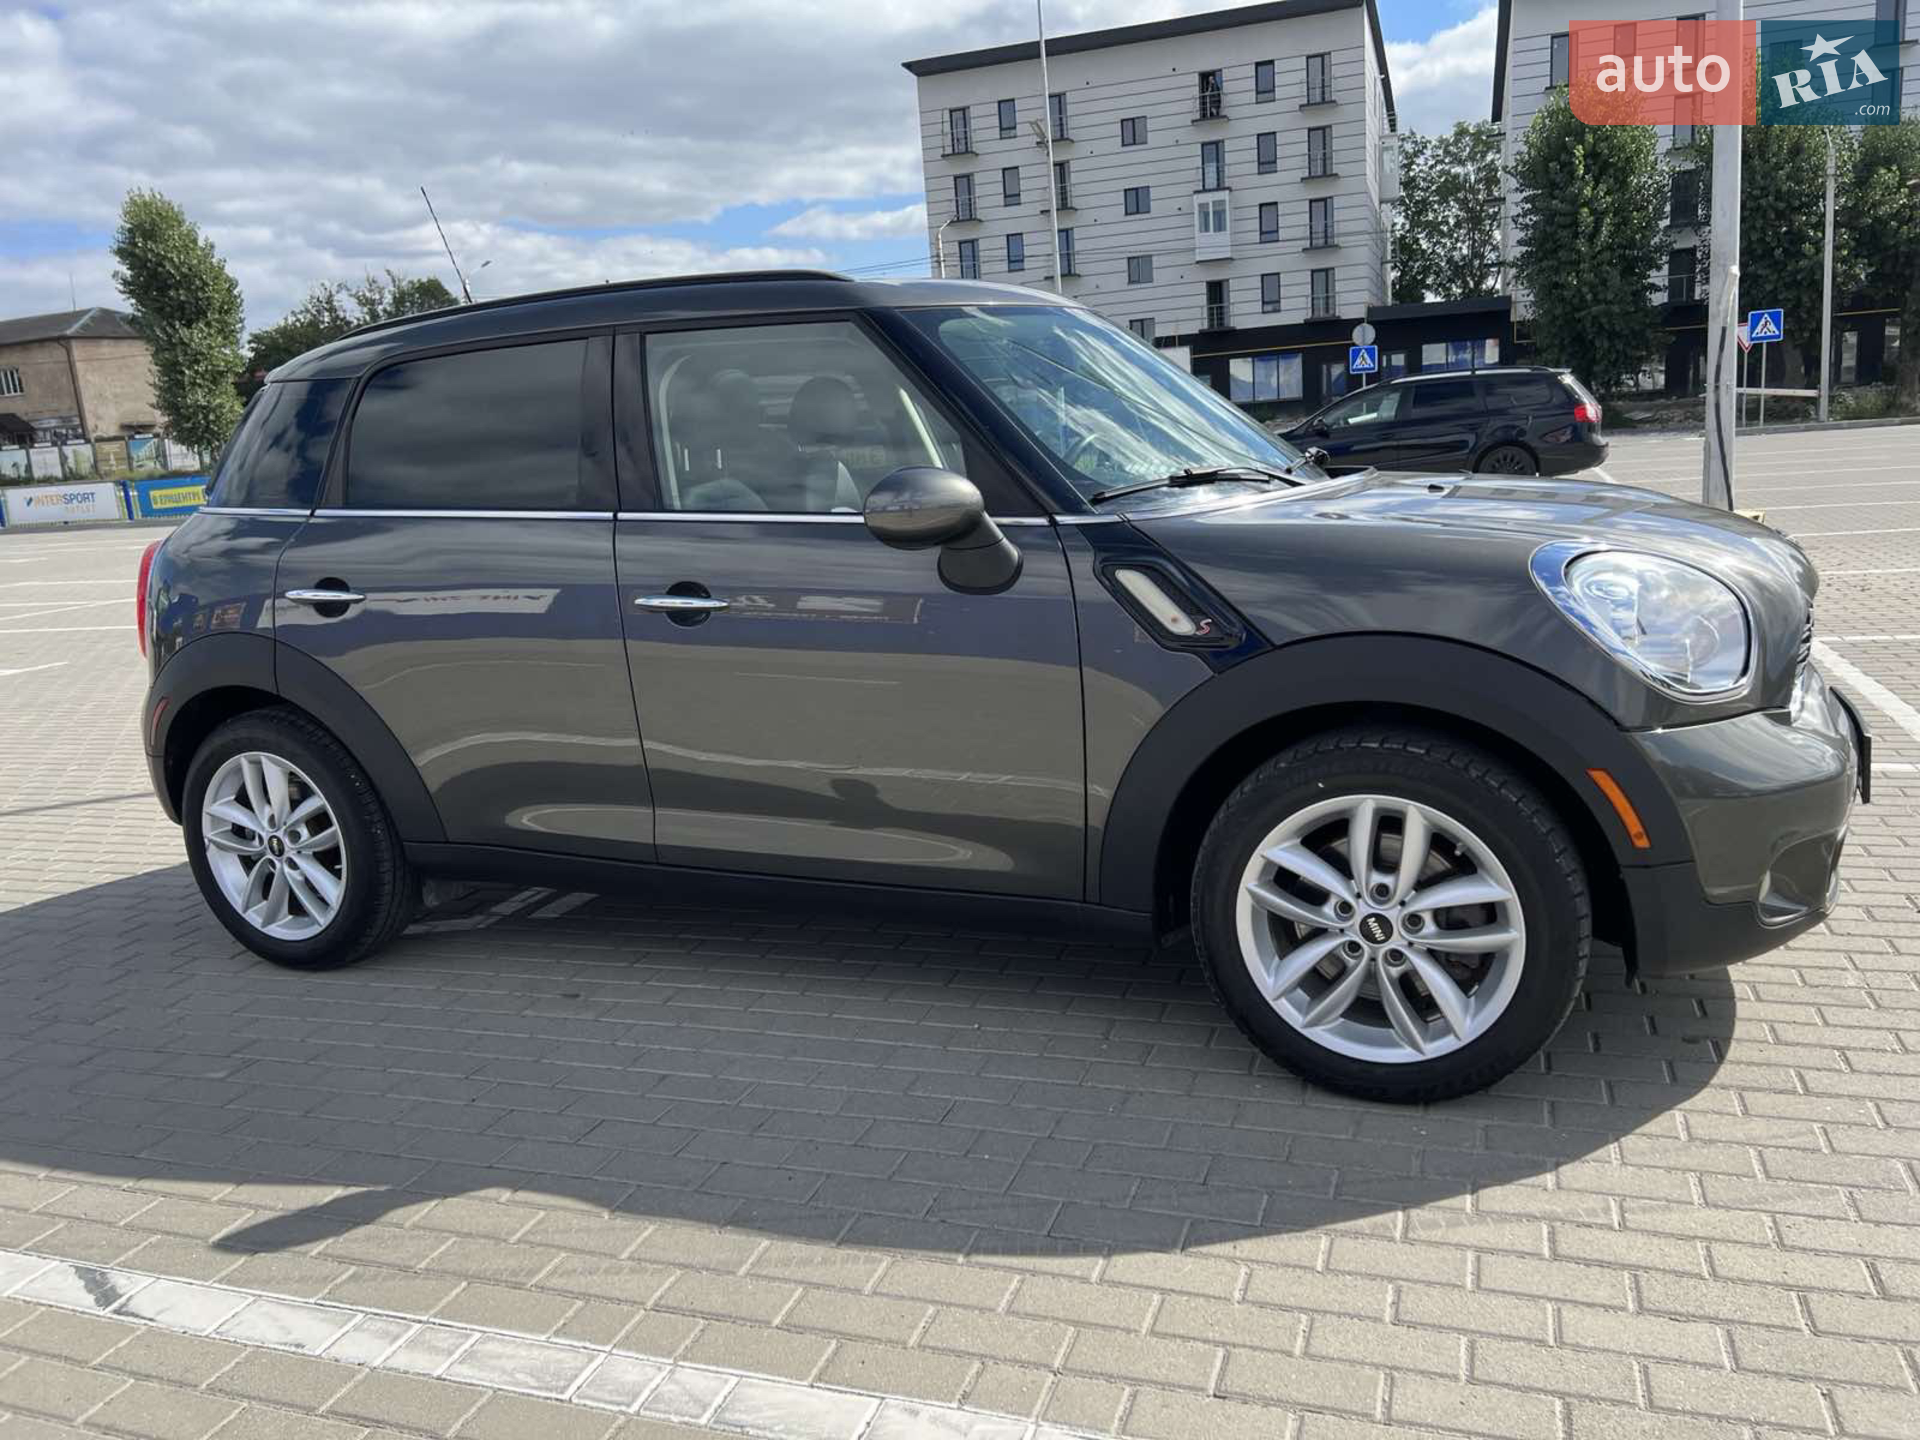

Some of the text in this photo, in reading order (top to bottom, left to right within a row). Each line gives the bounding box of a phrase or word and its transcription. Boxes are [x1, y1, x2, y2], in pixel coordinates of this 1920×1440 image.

[33, 492, 96, 509] INTERSPORT
[1195, 618, 1213, 636] S
[1366, 916, 1386, 941] MINI
